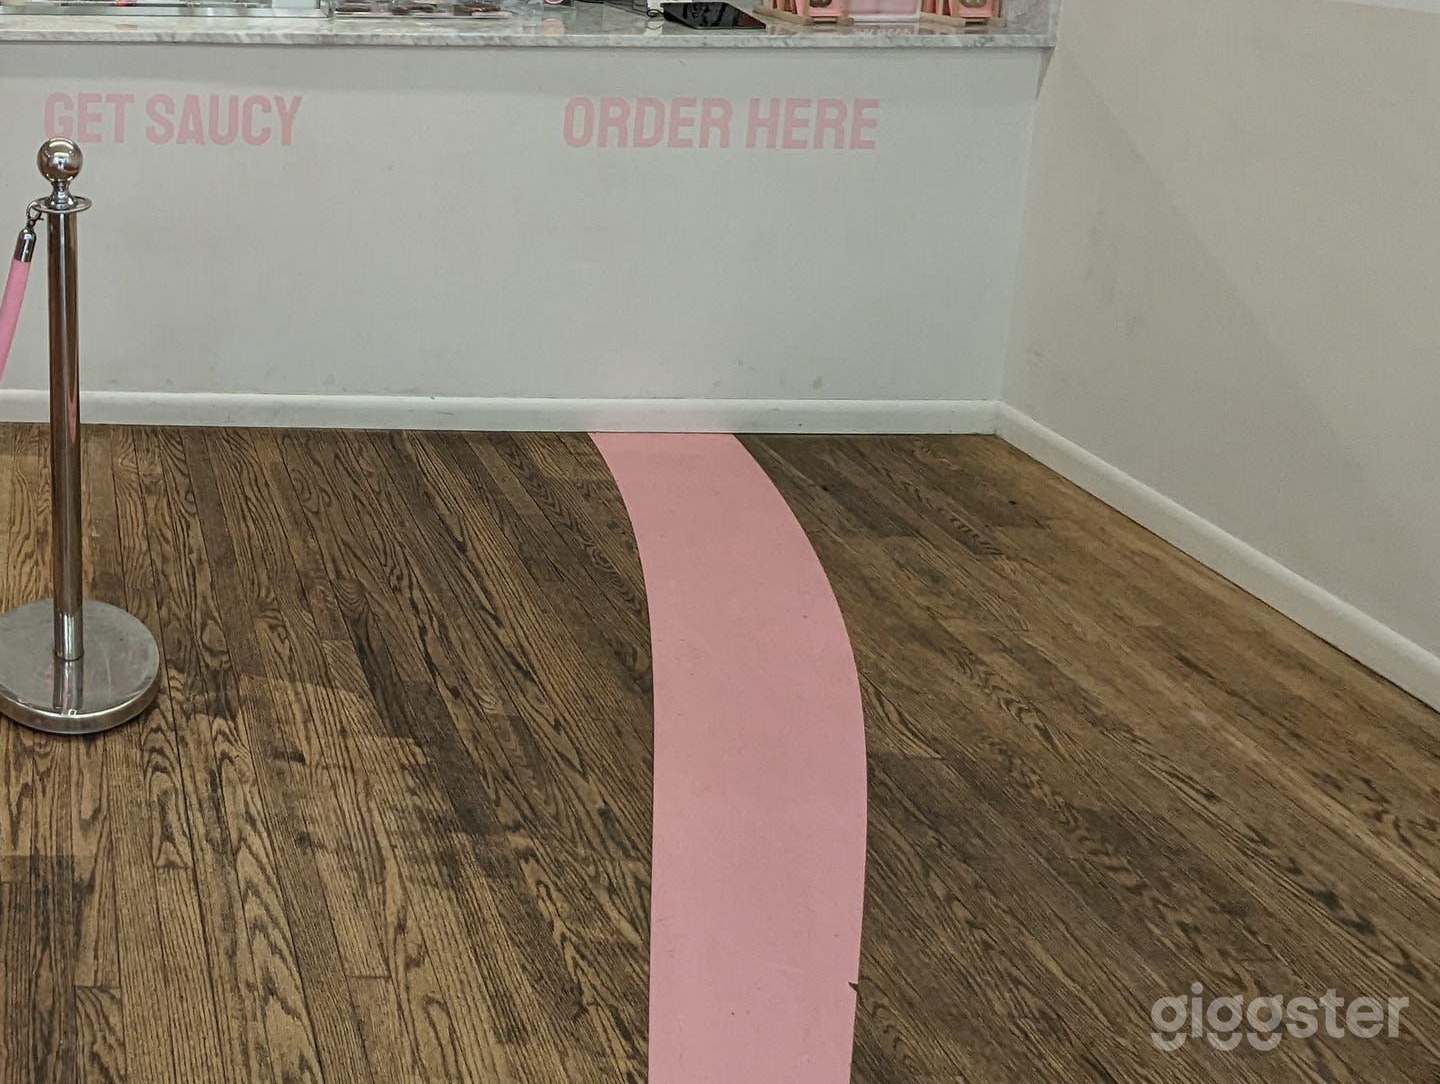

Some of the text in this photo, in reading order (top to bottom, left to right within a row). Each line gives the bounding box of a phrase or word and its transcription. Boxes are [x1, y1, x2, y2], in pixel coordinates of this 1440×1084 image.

[43, 92, 303, 146] GET SAUCY
[563, 96, 881, 150] ORDER HERE
